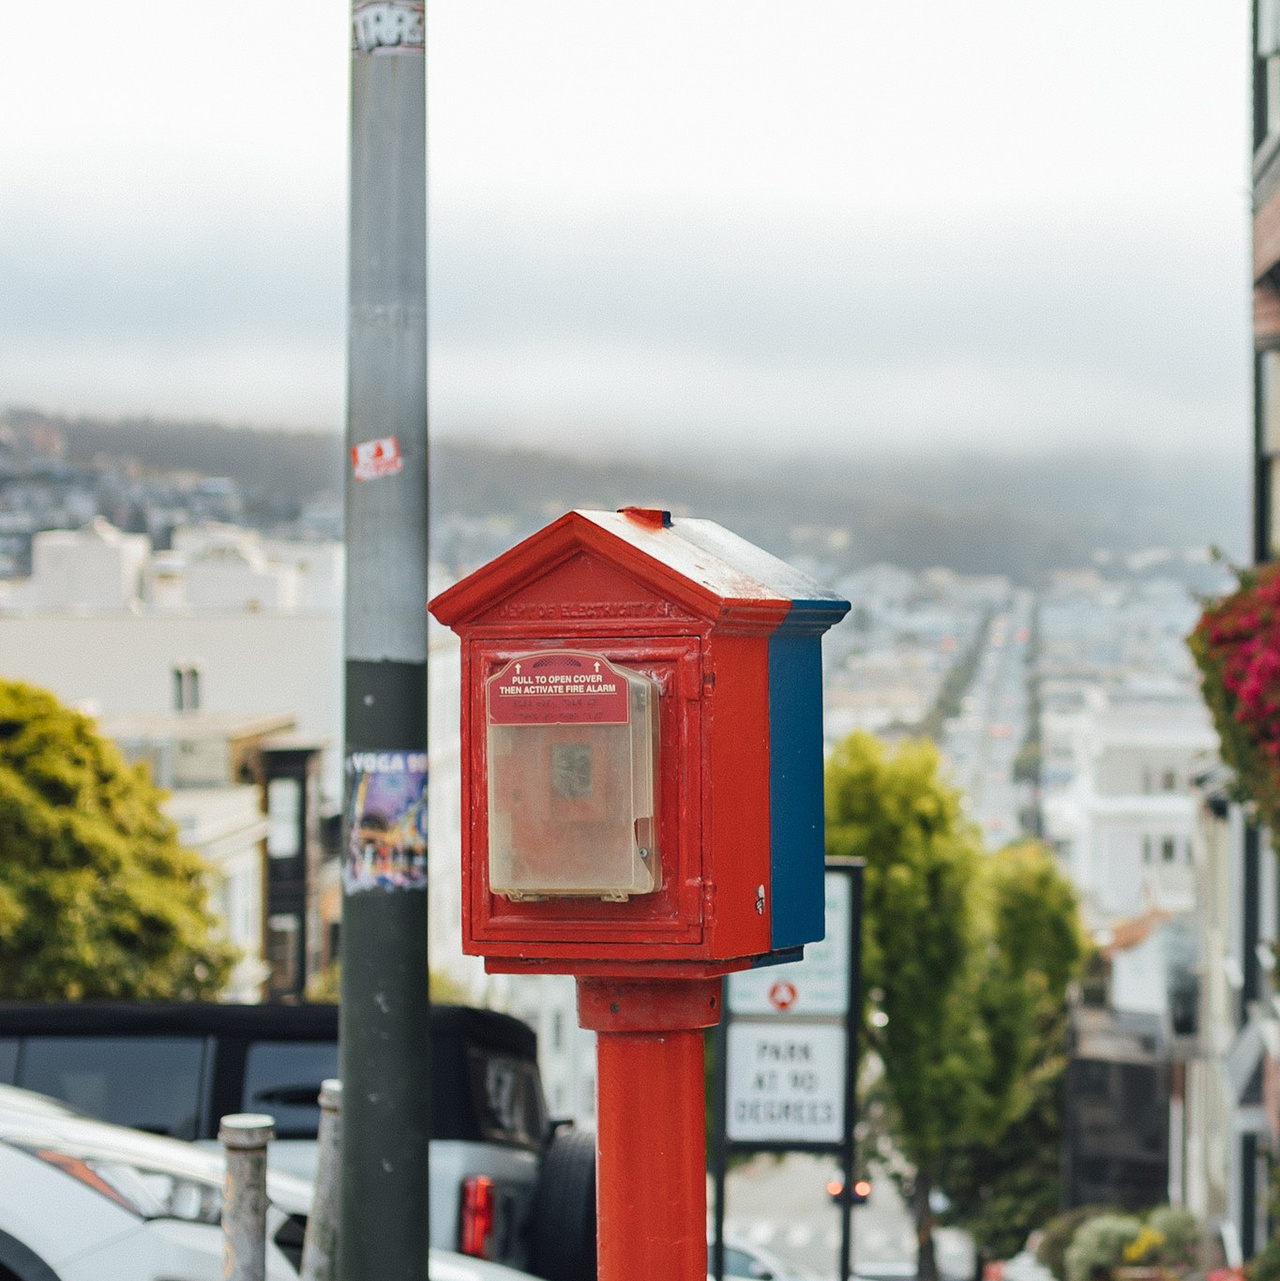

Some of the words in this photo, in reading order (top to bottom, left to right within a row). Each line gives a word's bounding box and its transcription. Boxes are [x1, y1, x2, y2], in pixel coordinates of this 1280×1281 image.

[511, 675, 534, 685] PULL
[535, 675, 547, 685] TO
[548, 674, 572, 685] OPEN
[573, 673, 603, 684] COVER
[499, 685, 523, 695] THEN
[523, 685, 565, 695] ACTIVATE
[565, 684, 585, 694] FIRE
[585, 683, 616, 693] ALARM
